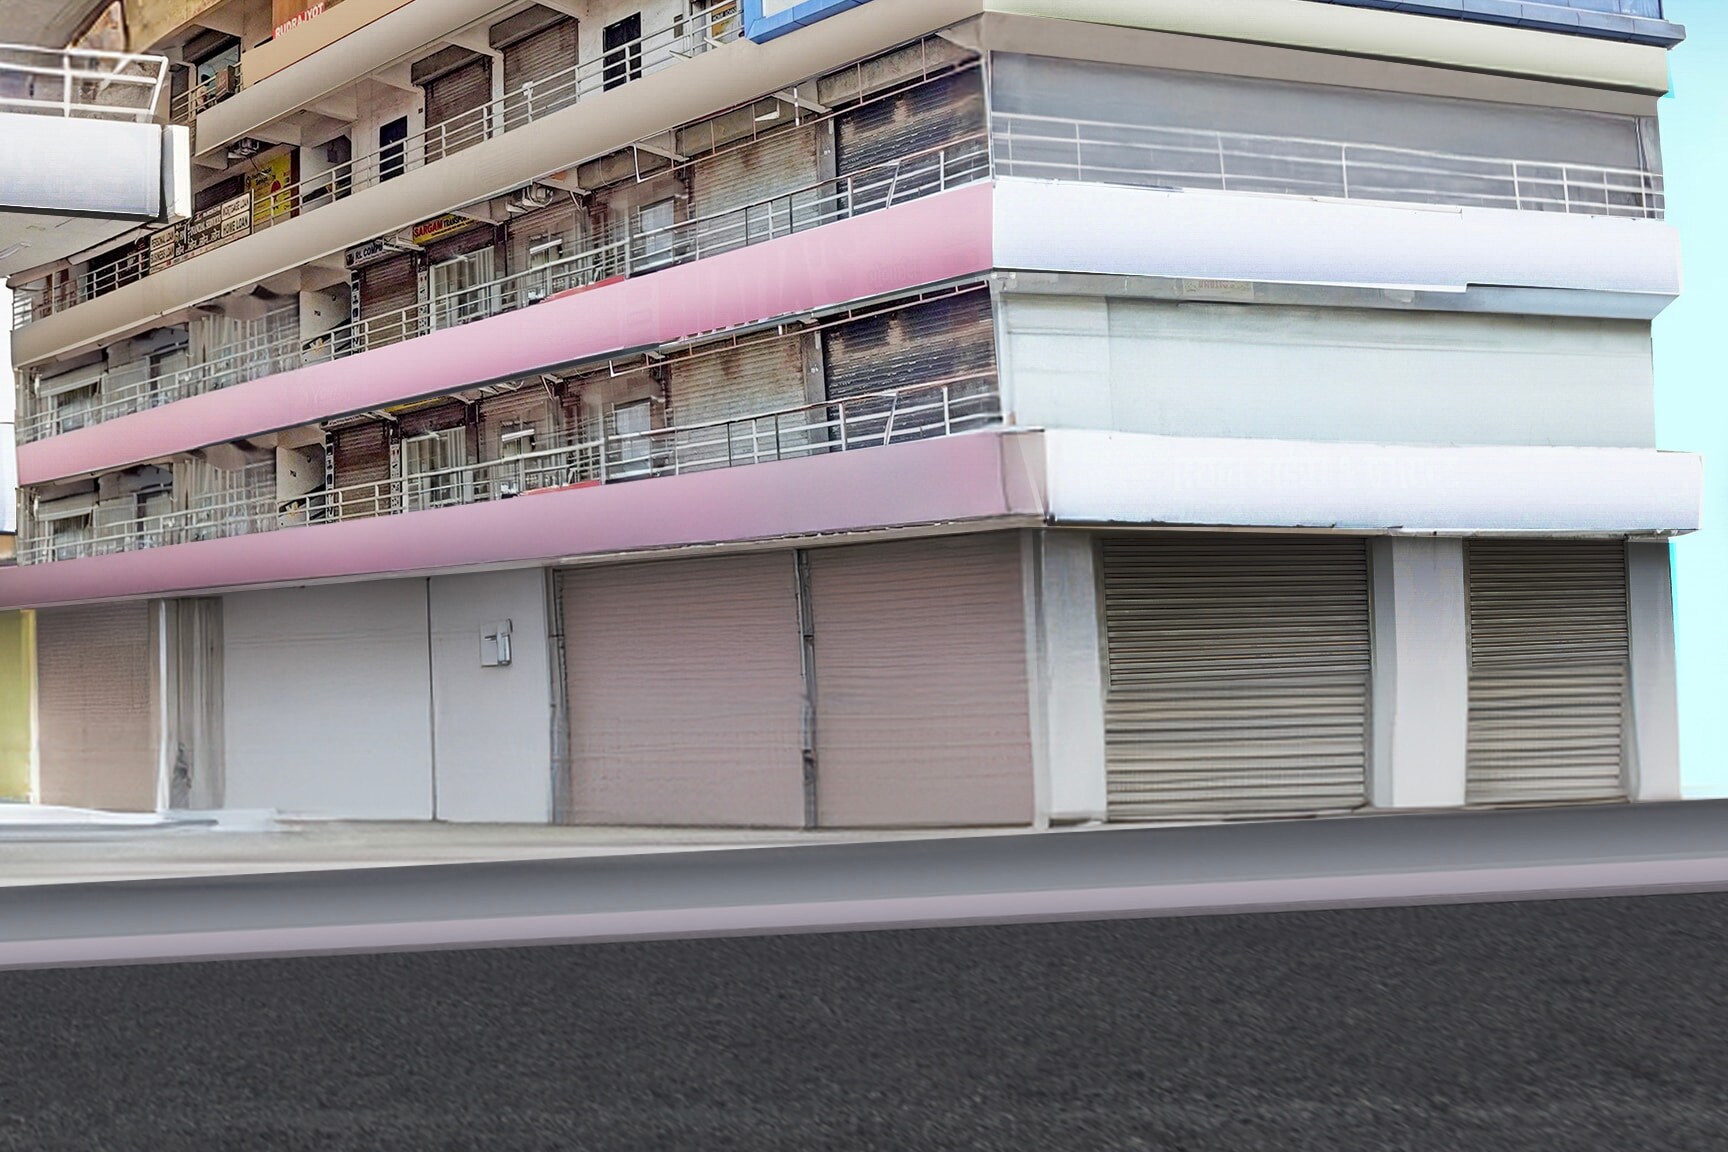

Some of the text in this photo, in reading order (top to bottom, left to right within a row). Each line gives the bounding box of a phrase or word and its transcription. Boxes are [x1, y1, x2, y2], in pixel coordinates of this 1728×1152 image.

[223, 215, 248, 234] HOME LOAN
[414, 220, 443, 237] SARGAM
